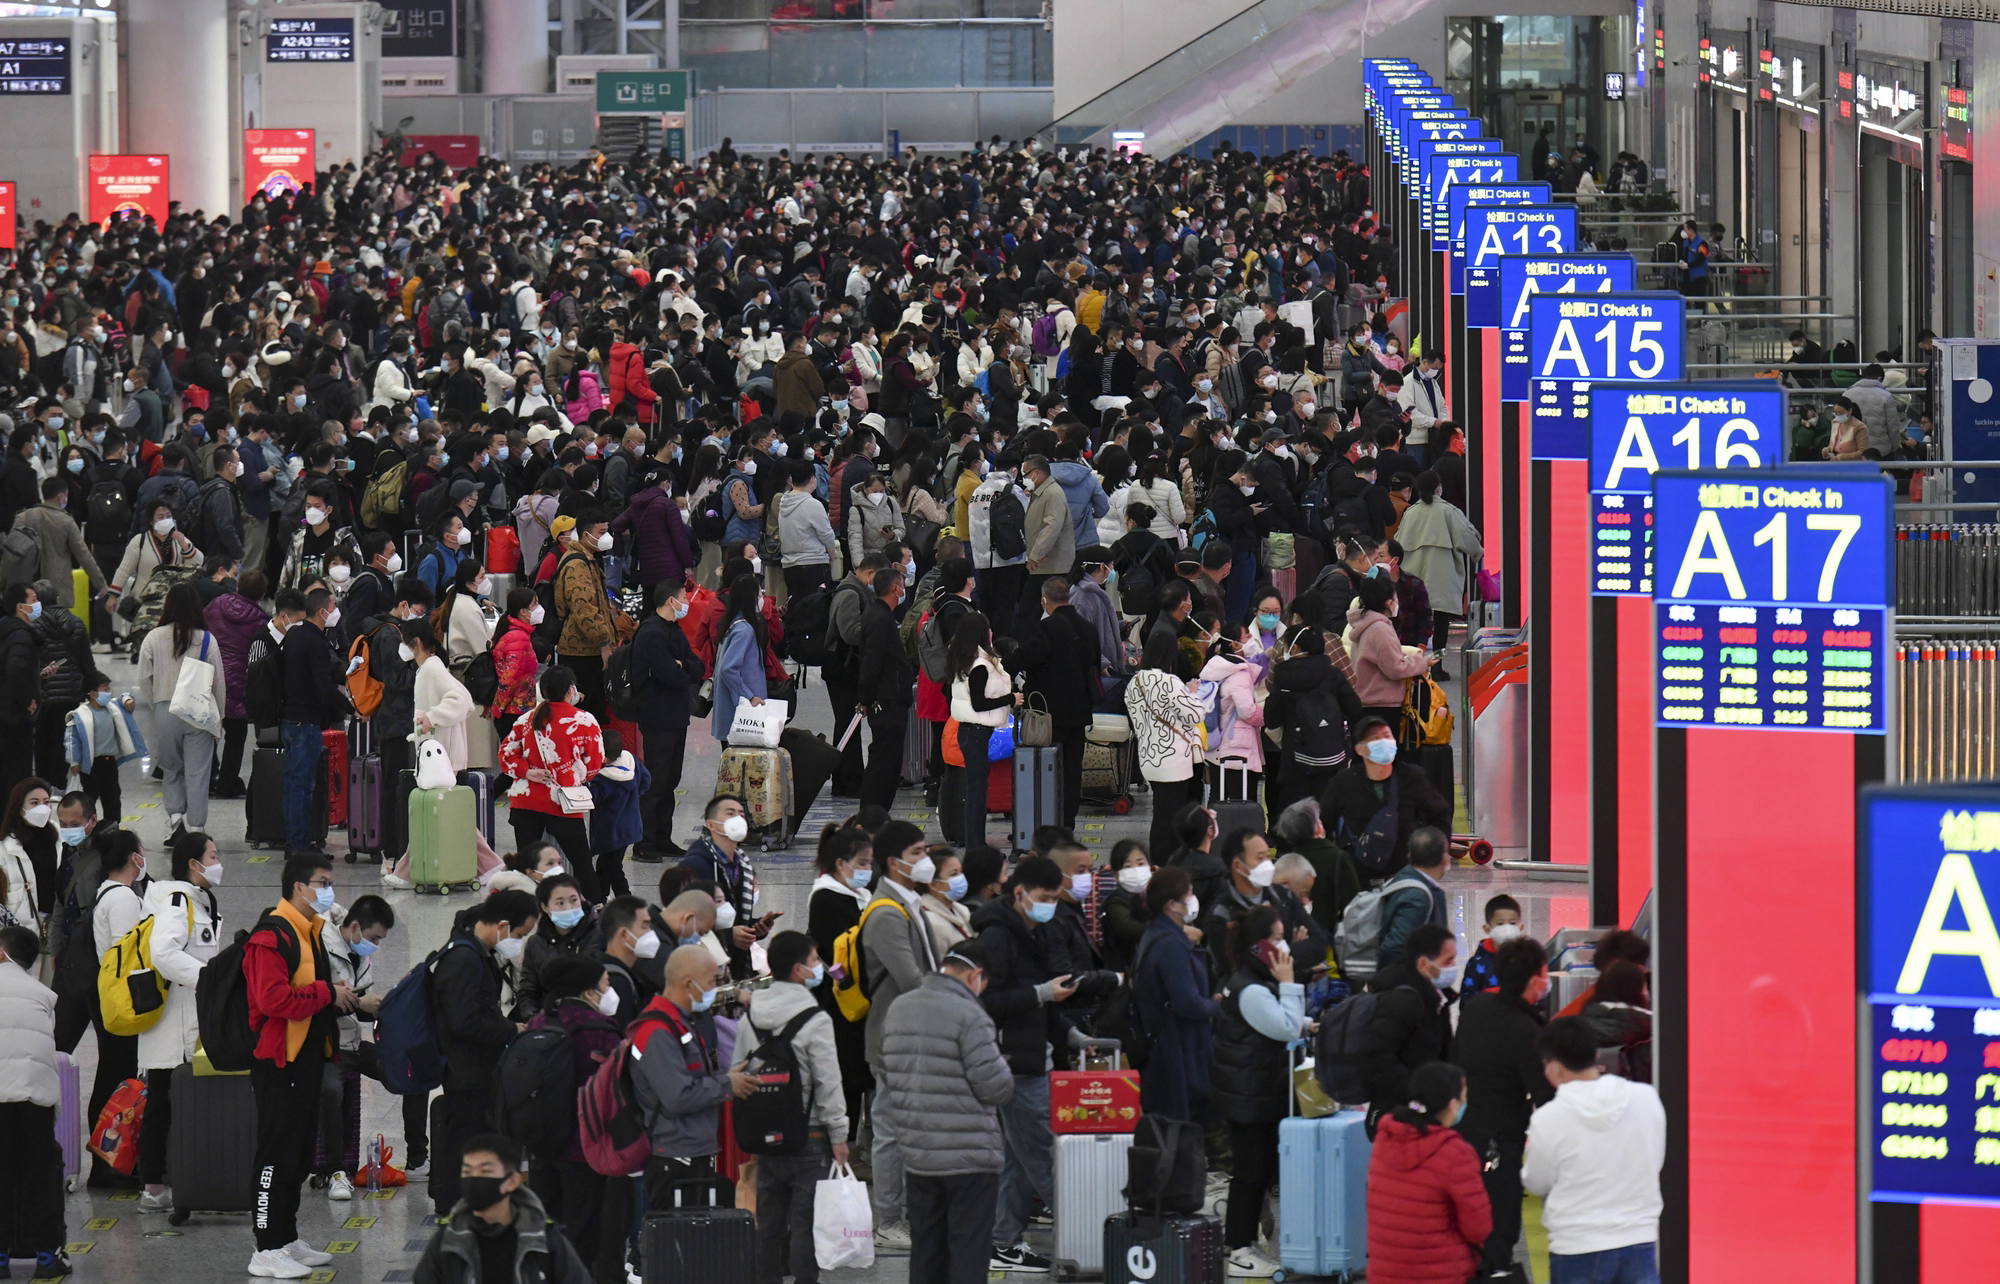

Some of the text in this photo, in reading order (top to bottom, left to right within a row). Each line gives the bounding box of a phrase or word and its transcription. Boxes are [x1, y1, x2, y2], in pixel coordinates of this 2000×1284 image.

[408, 8, 445, 27] 出口
[301, 21, 316, 32] A1
[2, 62, 20, 75] A1
[642, 83, 671, 95] 出口
[1435, 143, 1486, 153] 检票口 Check in
[1448, 158, 1502, 168] 检票口 Check in
[1468, 189, 1530, 200] 检票口 Check in
[1487, 211, 1555, 223] 检票口 Check in
[1474, 224, 1564, 267] A13
[1525, 262, 1607, 276] 检票口 Check in
[1559, 301, 1653, 318] 检票口 Check in
[1541, 318, 1665, 379] A15
[1627, 394, 1747, 415] 检票口 Check in
[1604, 416, 1761, 489] A16
[1698, 483, 1843, 509] 检票口 Check in
[1671, 510, 1862, 603] A17
[738, 718, 765, 728] MOKA
[256, 1165, 275, 1230] KEEP MOVING
